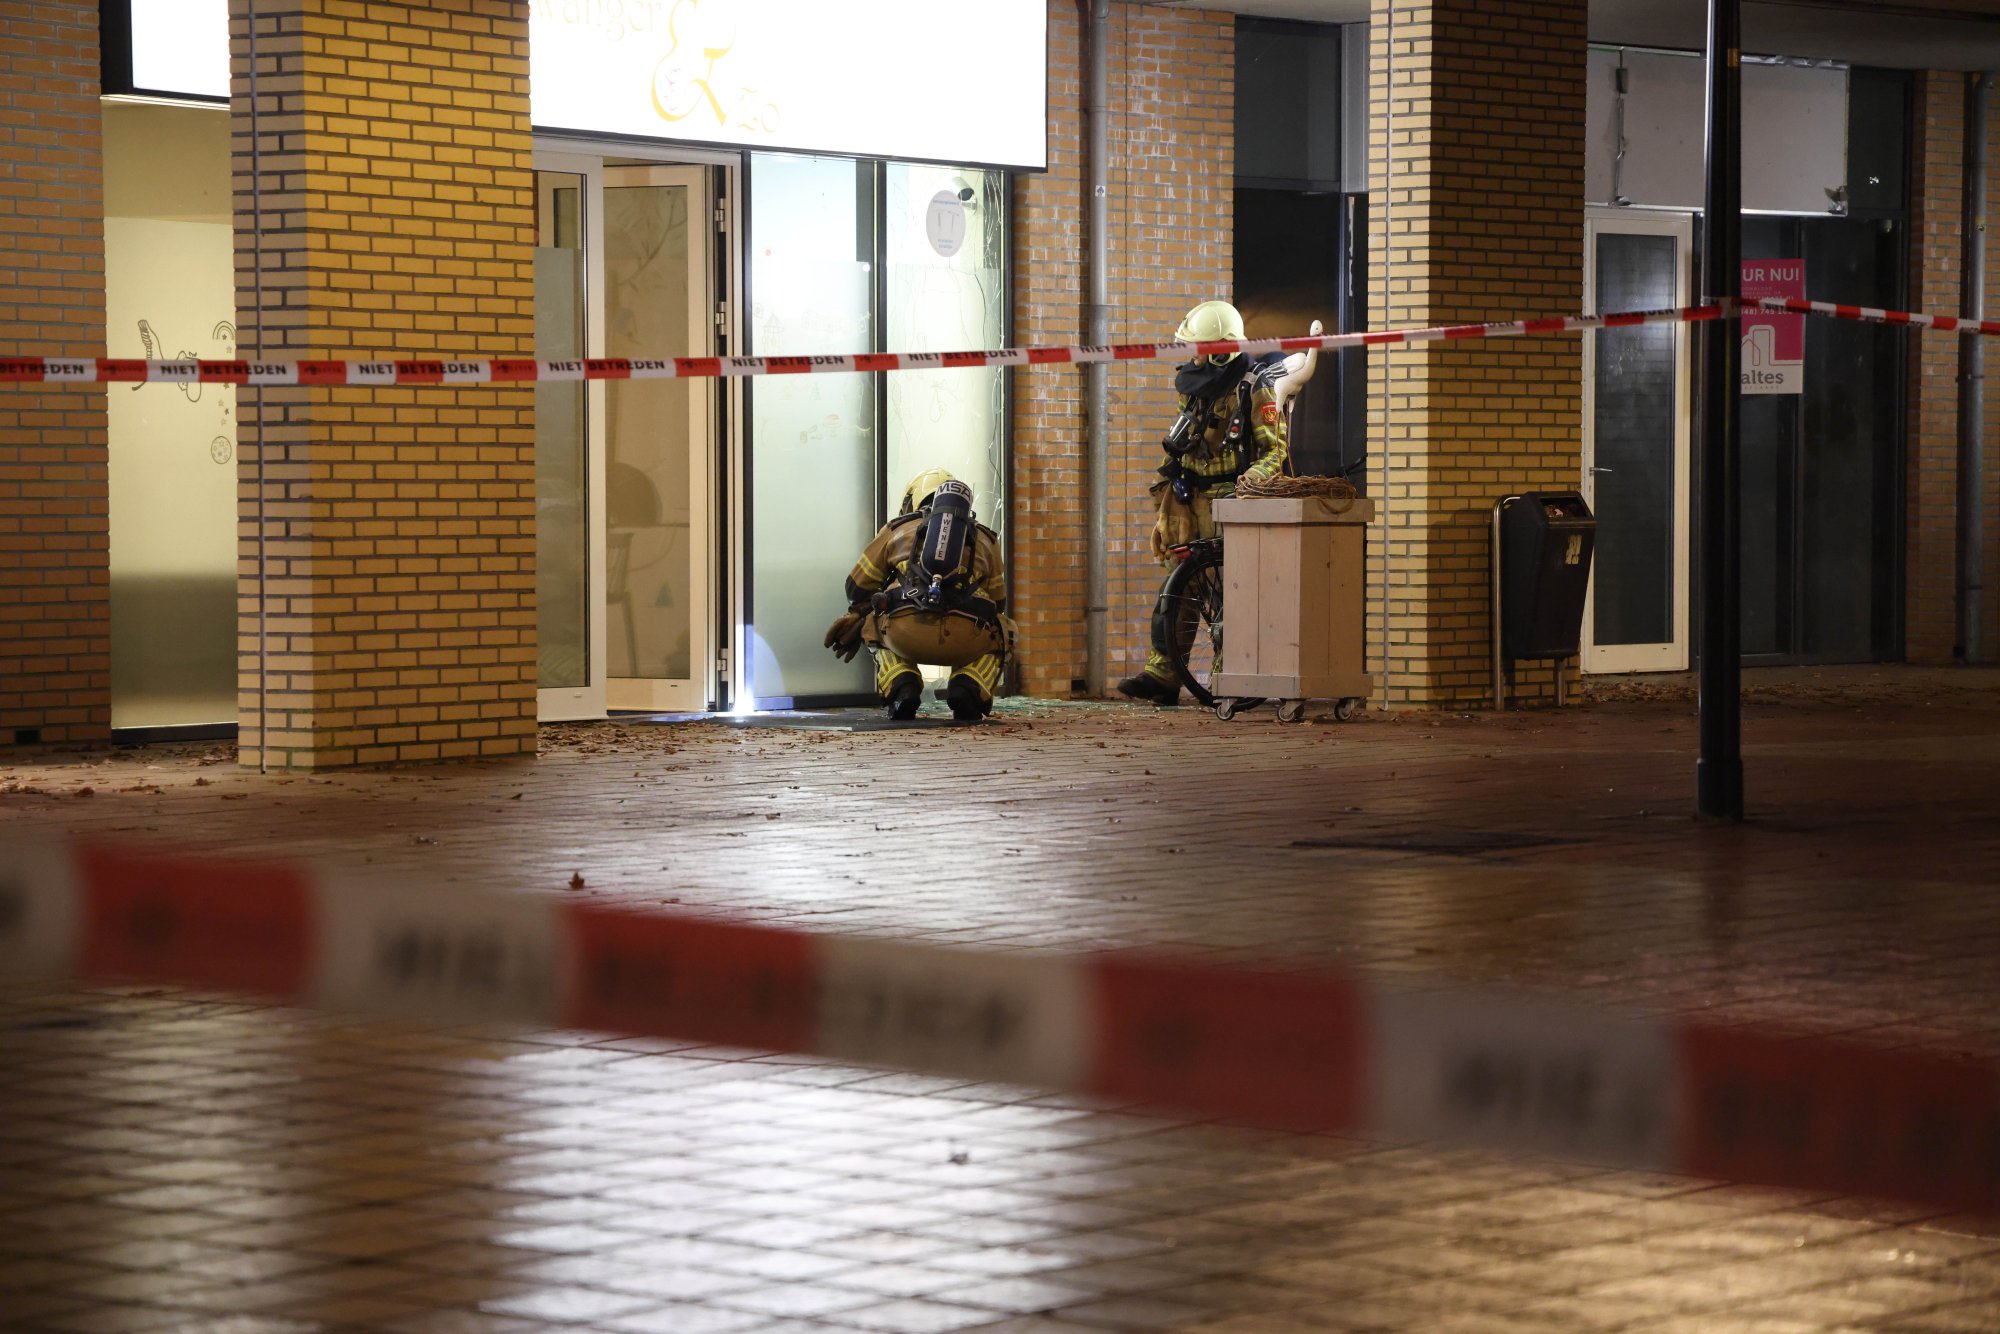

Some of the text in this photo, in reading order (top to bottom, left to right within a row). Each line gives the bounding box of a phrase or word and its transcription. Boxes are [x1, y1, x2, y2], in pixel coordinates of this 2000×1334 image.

[1770, 267, 1799, 282] NU!
[160, 365, 197, 375] NIET
[203, 364, 286, 375] BETREDEN
[358, 364, 393, 375] NIET
[400, 363, 479, 374] BETREDEN
[549, 361, 582, 372] NIET
[587, 360, 665, 371] BETREDEN
[732, 358, 764, 368] NIET
[768, 355, 844, 366] BETREDEN
[908, 352, 940, 361] NIET
[937, 481, 973, 501] MSA
